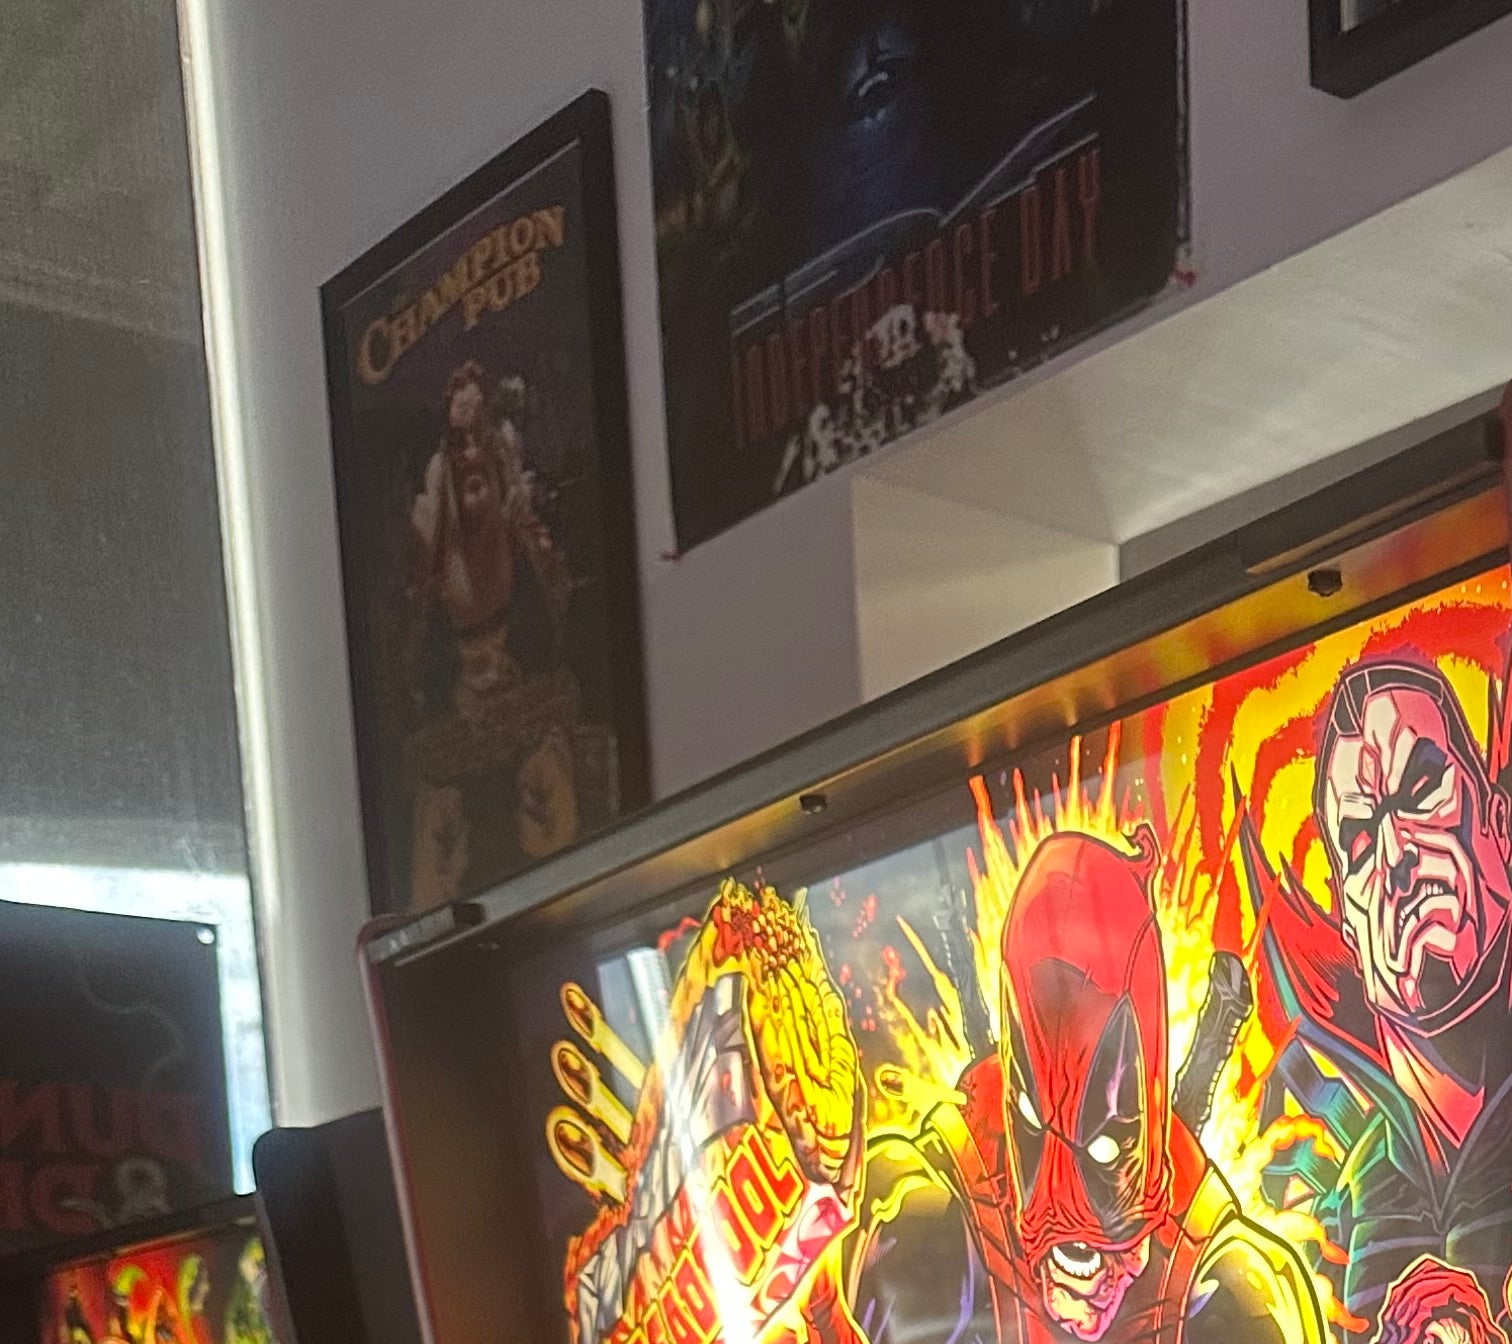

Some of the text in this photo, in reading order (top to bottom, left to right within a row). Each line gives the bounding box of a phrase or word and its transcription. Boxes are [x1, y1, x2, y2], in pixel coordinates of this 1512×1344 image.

[356, 205, 567, 385] CHAMPION
[463, 251, 542, 332] PUB
[1019, 146, 1104, 296] DAY
